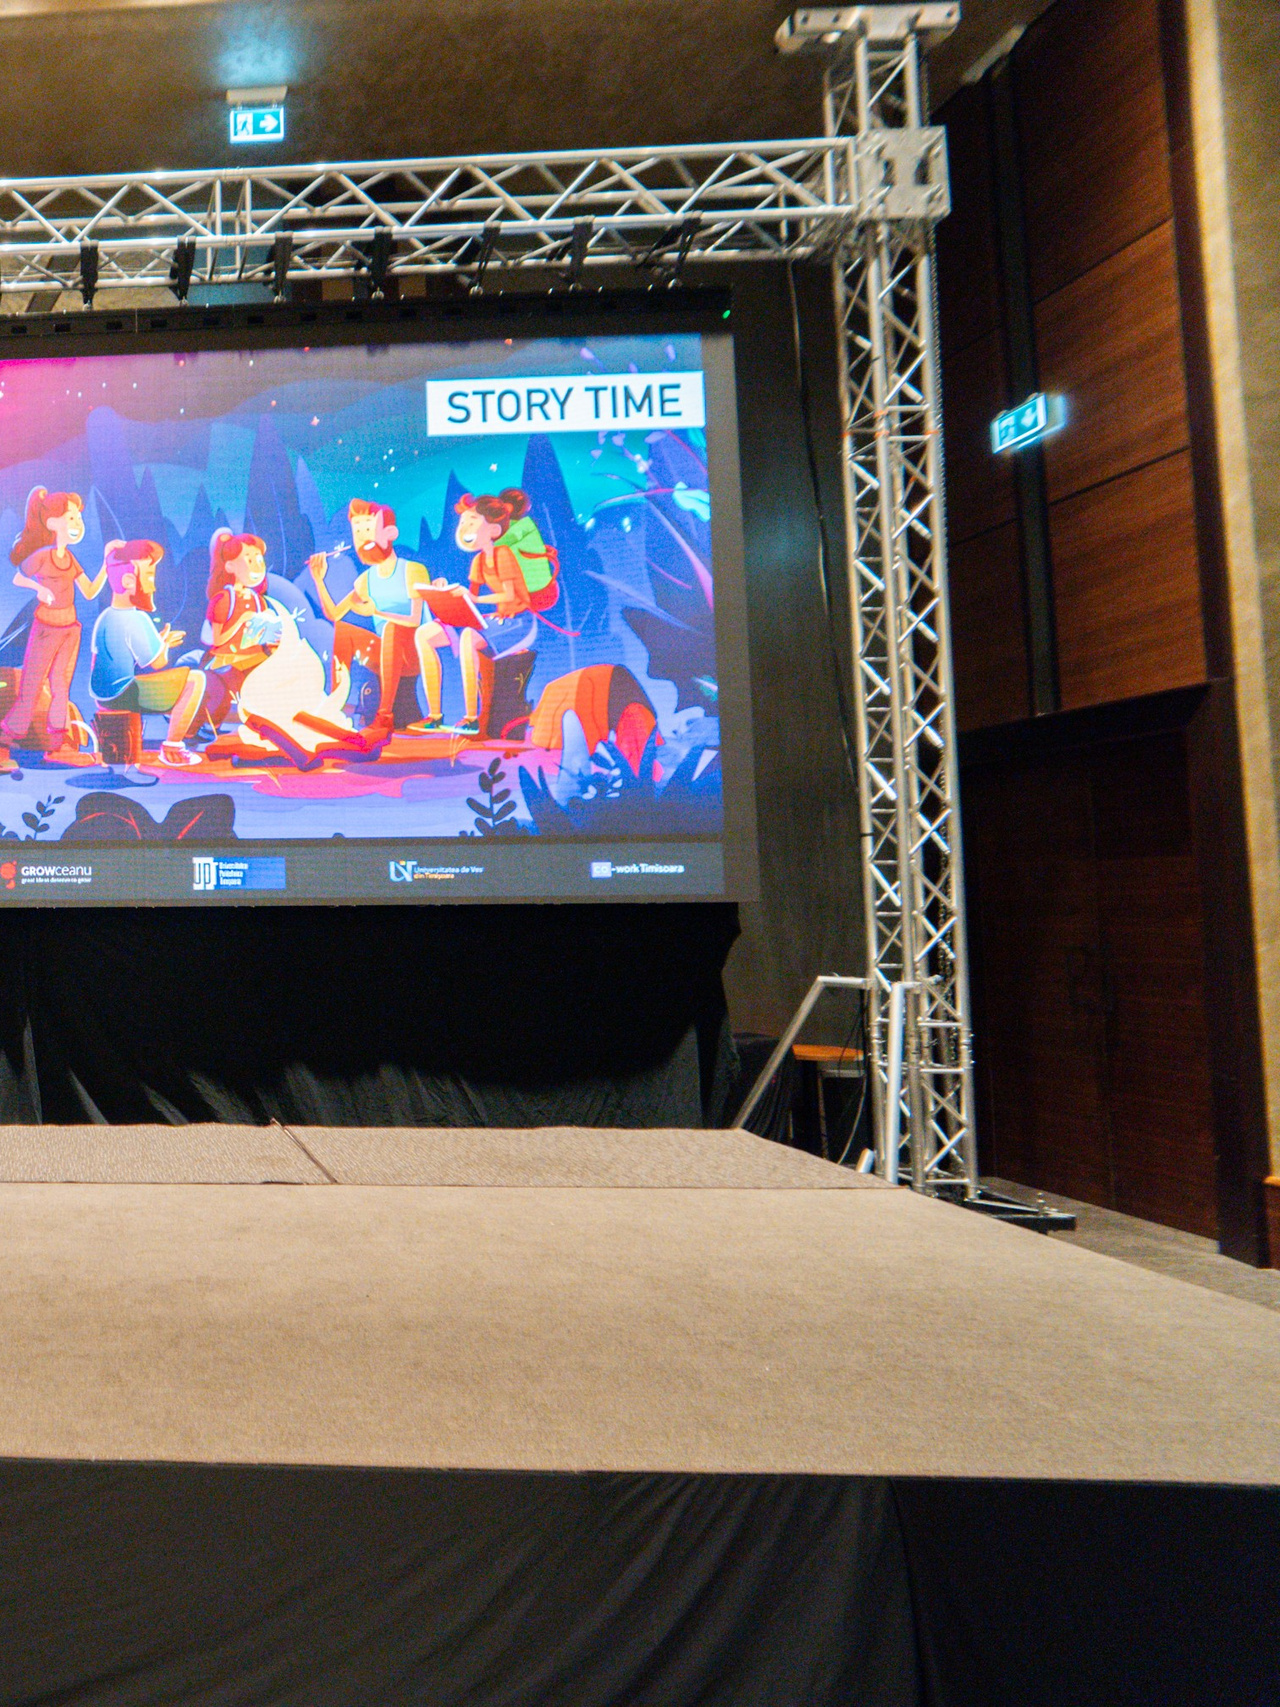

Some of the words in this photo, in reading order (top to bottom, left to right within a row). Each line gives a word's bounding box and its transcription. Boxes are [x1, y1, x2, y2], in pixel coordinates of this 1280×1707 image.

[447, 386, 574, 423] STORY
[585, 383, 683, 419] TIME
[21, 866, 92, 876] GROWceanu
